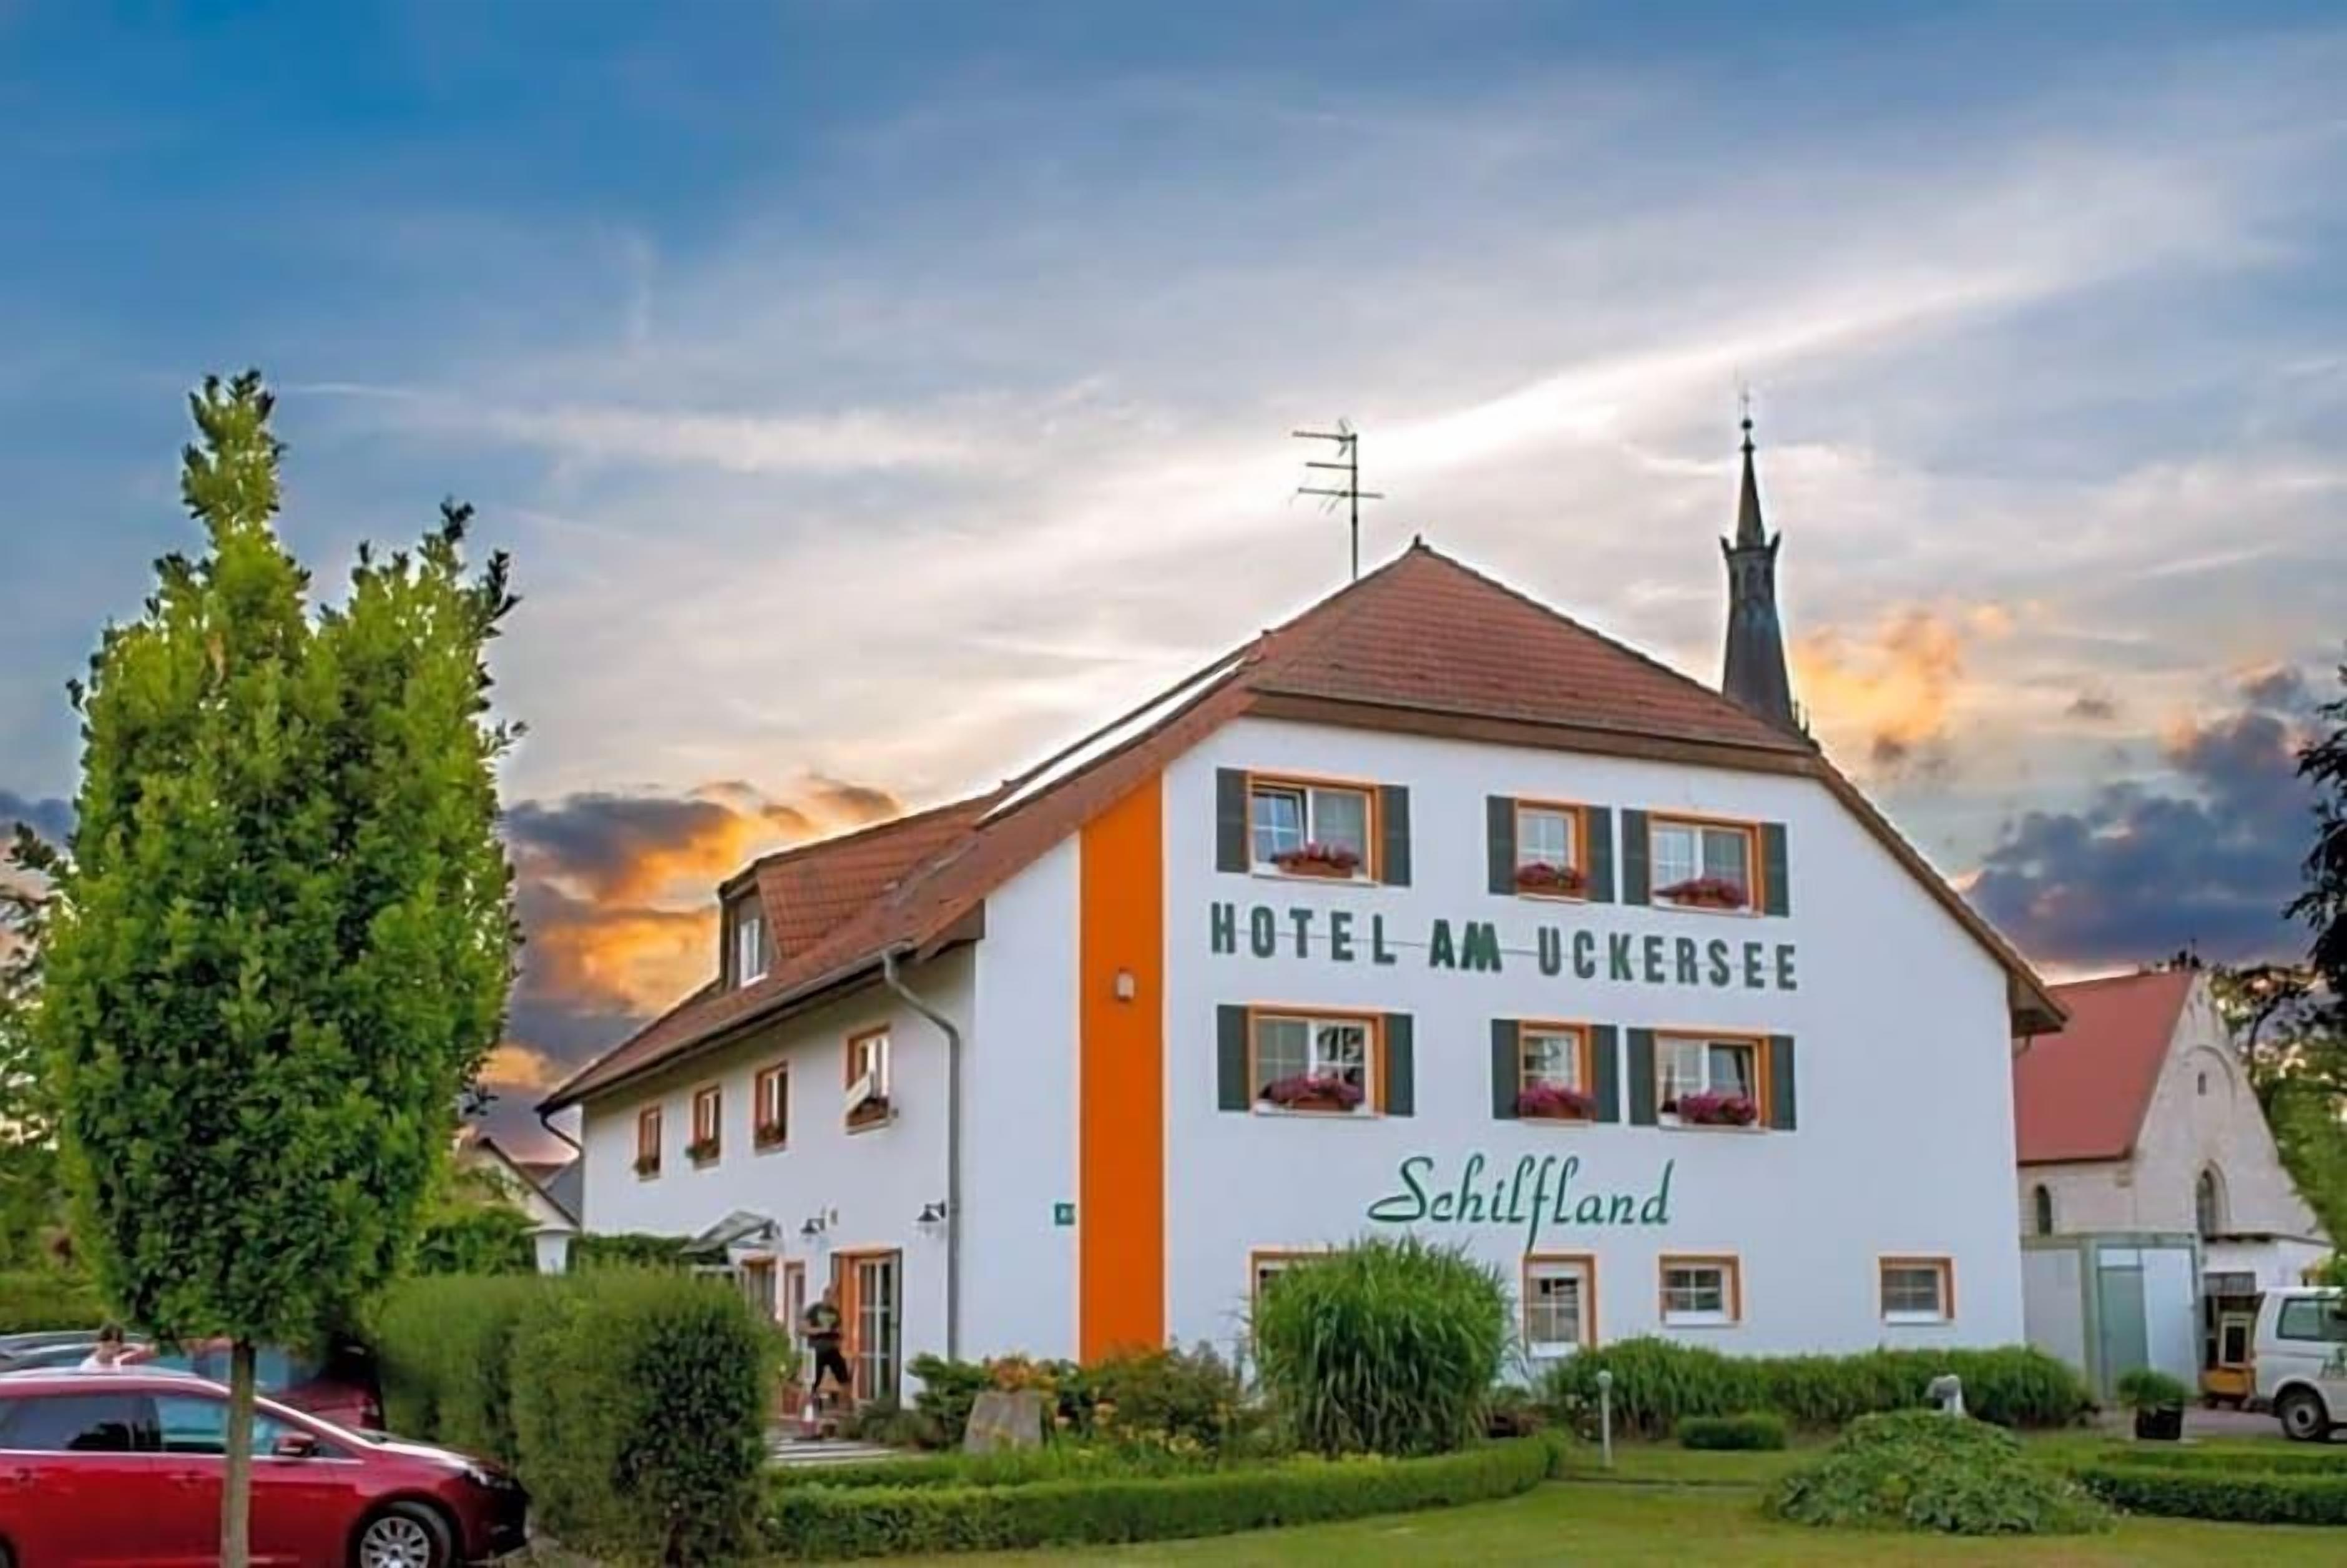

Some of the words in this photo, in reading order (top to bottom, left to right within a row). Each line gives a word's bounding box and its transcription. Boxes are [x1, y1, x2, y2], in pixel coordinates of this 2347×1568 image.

[1210, 901, 1397, 965] HOTEL
[1428, 918, 1504, 973] AM
[1537, 926, 1798, 991] UCKERSEE
[1366, 1153, 1675, 1252] Schilfland
